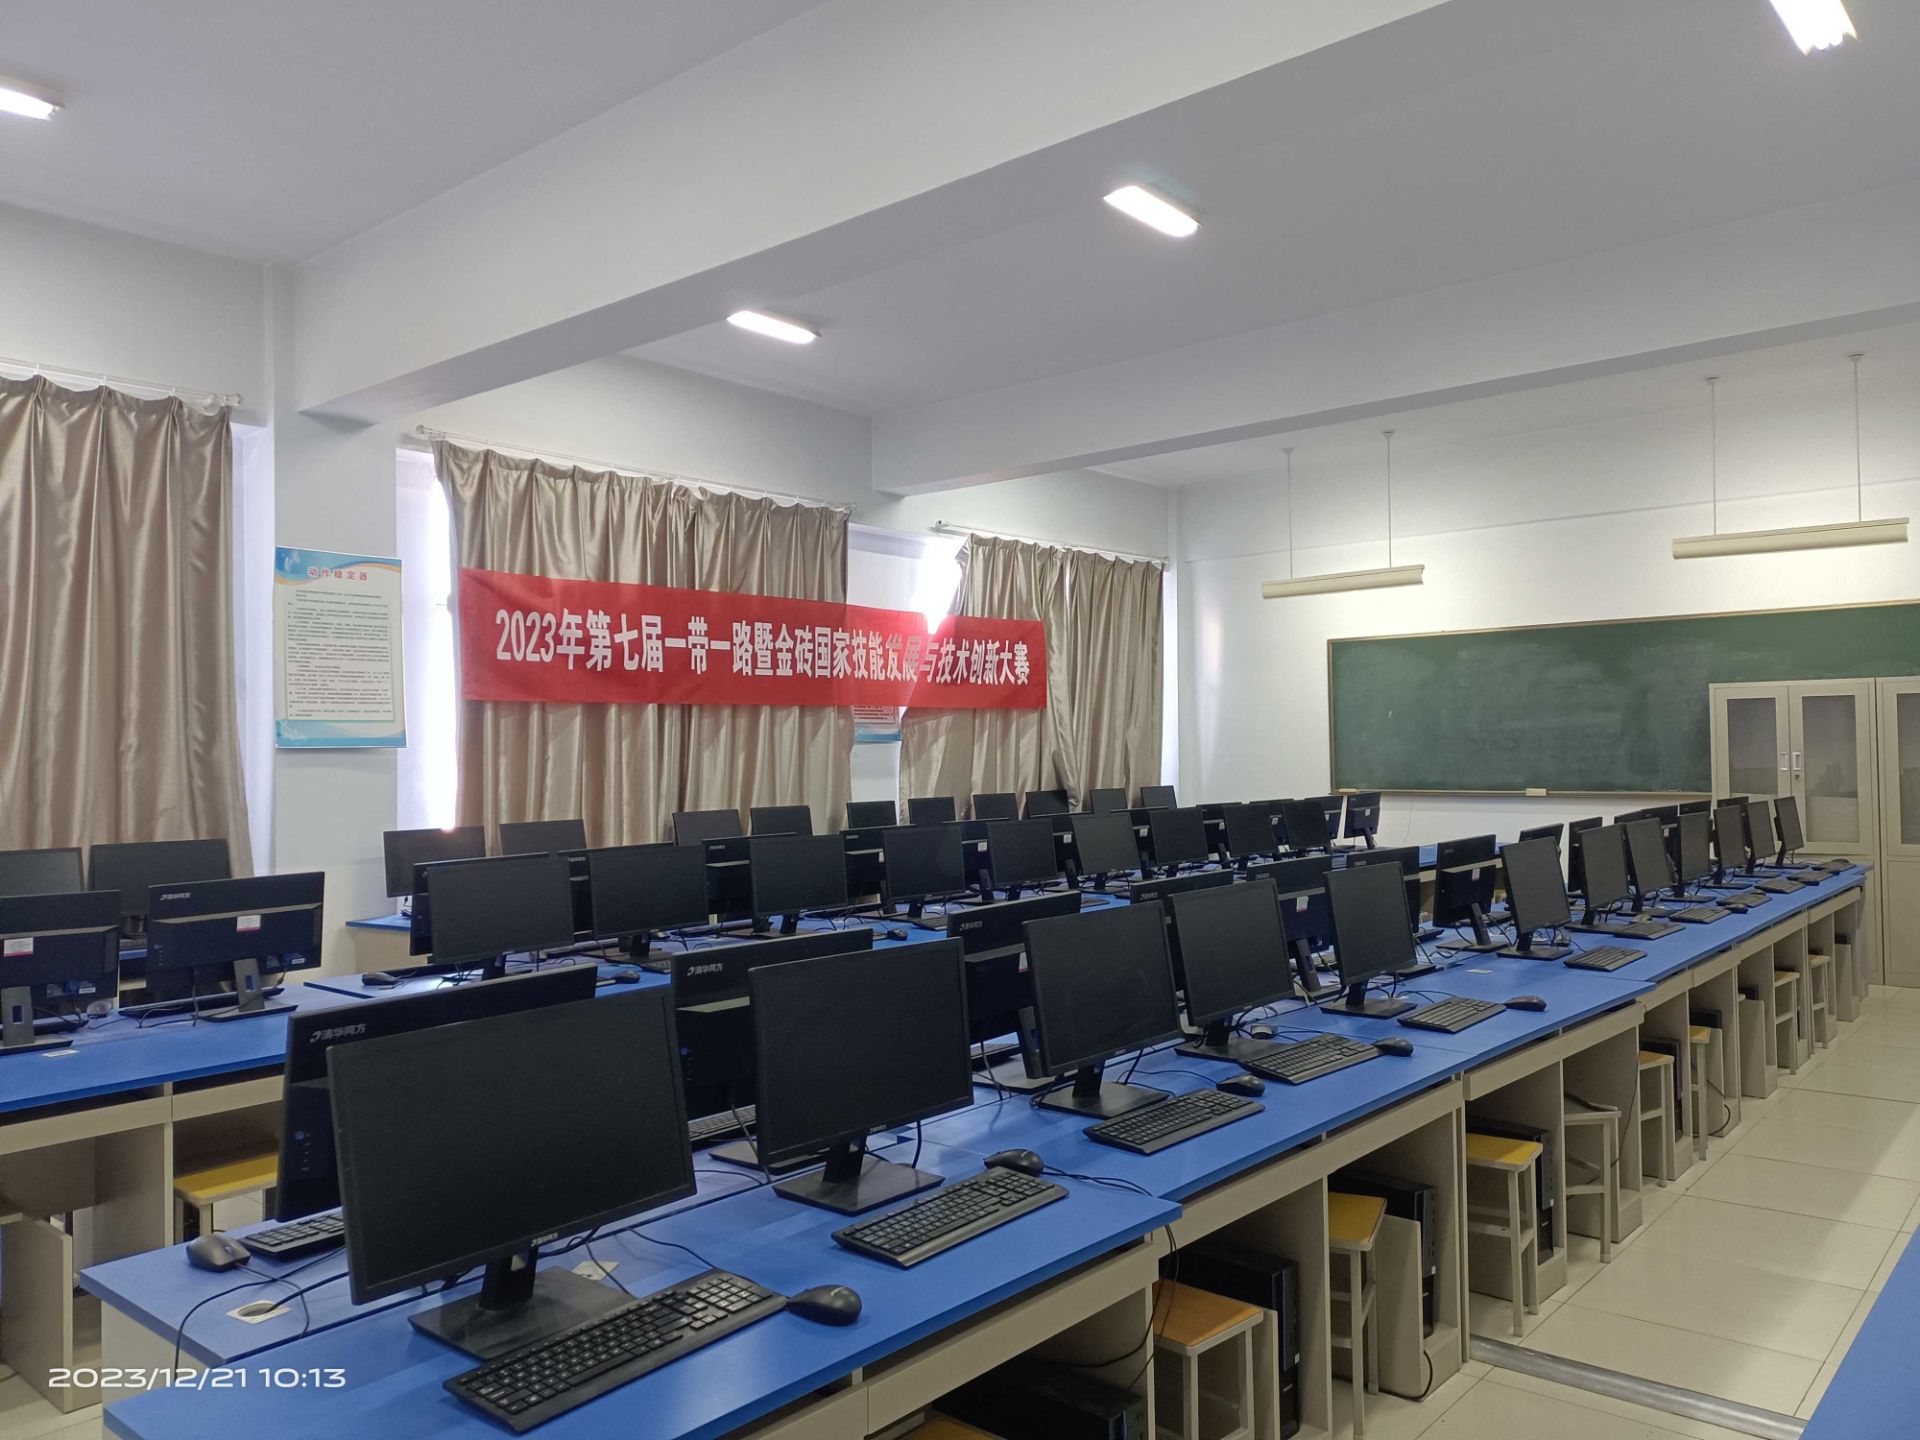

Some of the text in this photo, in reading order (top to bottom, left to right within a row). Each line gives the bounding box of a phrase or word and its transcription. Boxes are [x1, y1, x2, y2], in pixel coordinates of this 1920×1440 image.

[496, 608, 1030, 686] 2023年第七届一带一路暨金砖国家技能发展与技术创新大赛
